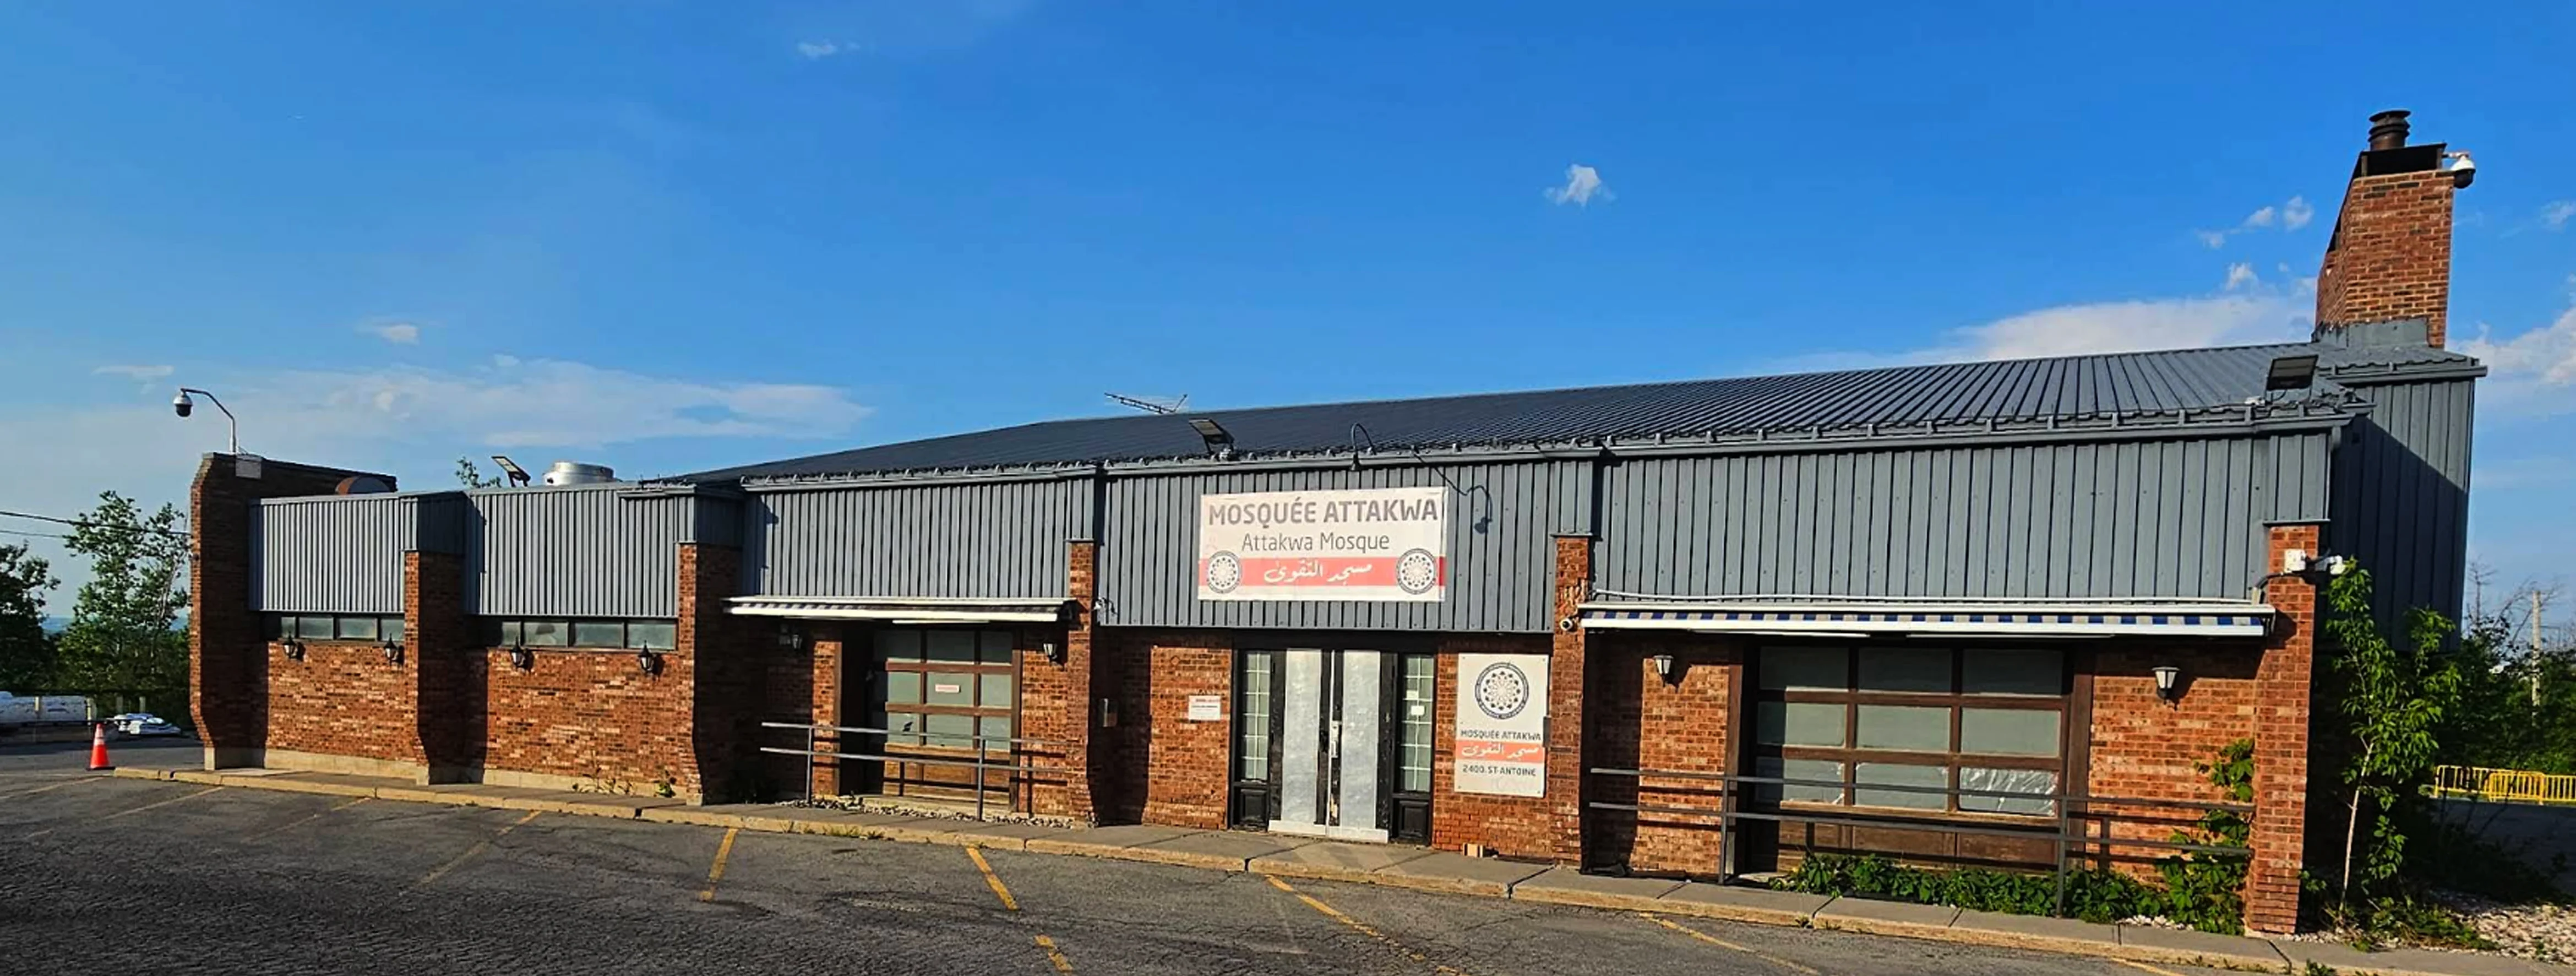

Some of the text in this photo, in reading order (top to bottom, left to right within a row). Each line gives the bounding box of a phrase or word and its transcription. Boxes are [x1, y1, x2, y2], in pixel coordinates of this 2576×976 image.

[1209, 497, 1437, 528] MOSQUÉE ATTAKWA
[1241, 532, 1390, 554] Attakwa Mosque
[1327, 563, 1373, 585] مسجد
[1501, 731, 1541, 741] ATTAKWA
